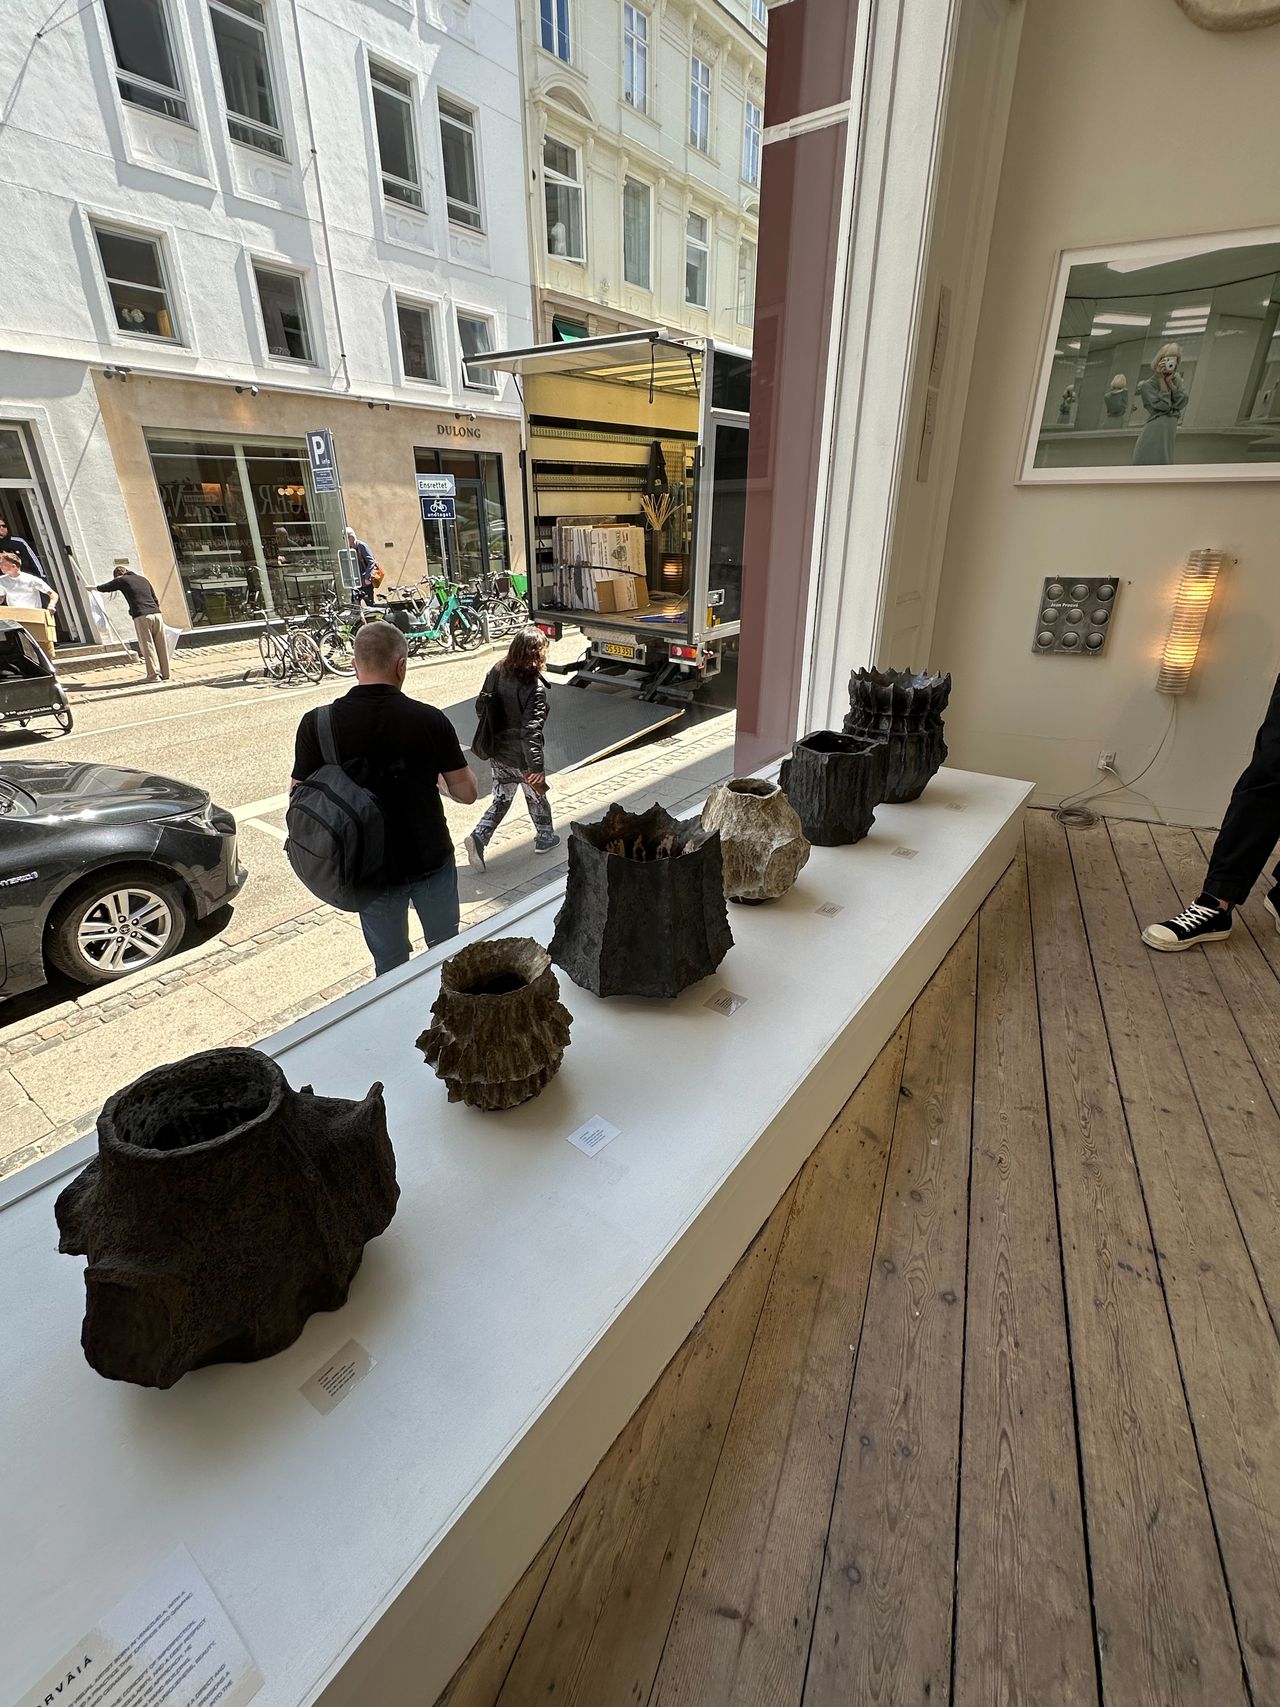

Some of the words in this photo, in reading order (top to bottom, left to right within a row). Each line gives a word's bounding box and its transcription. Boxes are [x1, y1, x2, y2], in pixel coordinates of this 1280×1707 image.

[437, 424, 481, 439] DULONG
[311, 435, 325, 465] P
[419, 481, 448, 489] Ensrettet
